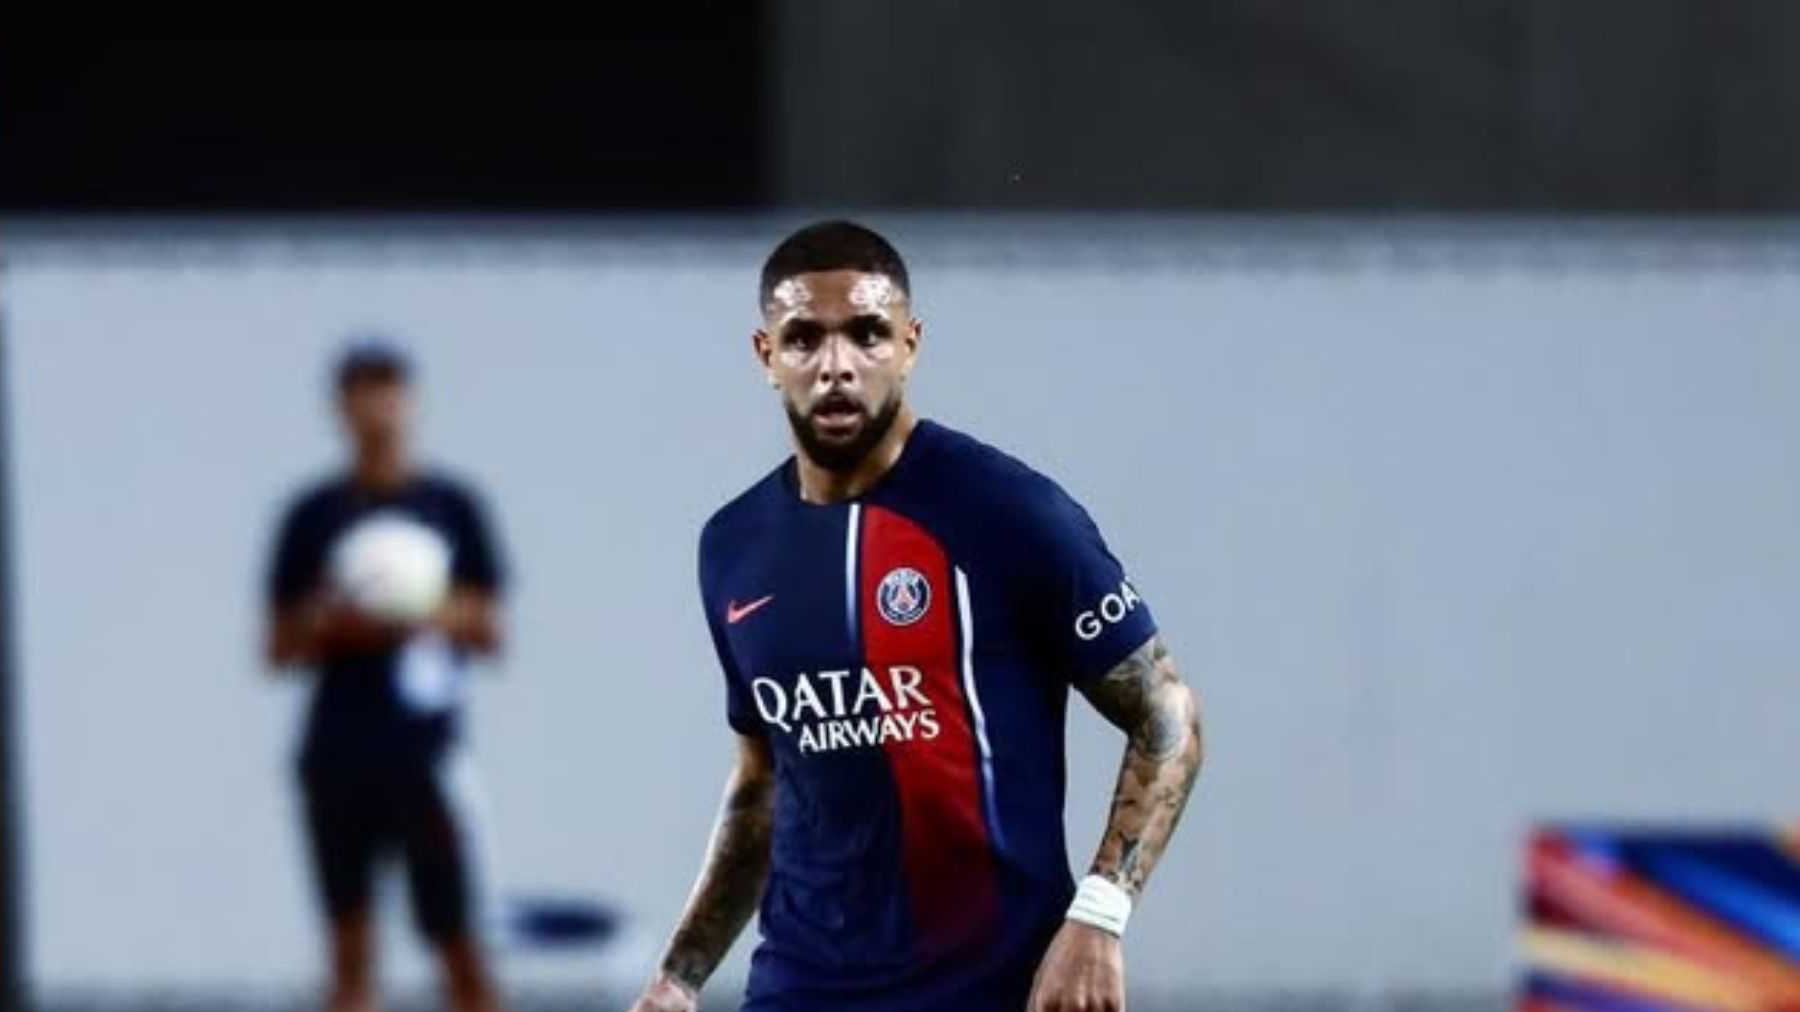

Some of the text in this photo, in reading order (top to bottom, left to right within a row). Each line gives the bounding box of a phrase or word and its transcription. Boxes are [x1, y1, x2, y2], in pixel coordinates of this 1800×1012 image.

[1075, 578, 1141, 640] GOA
[751, 665, 932, 733] QATAR
[798, 709, 940, 754] AIRWAYS
